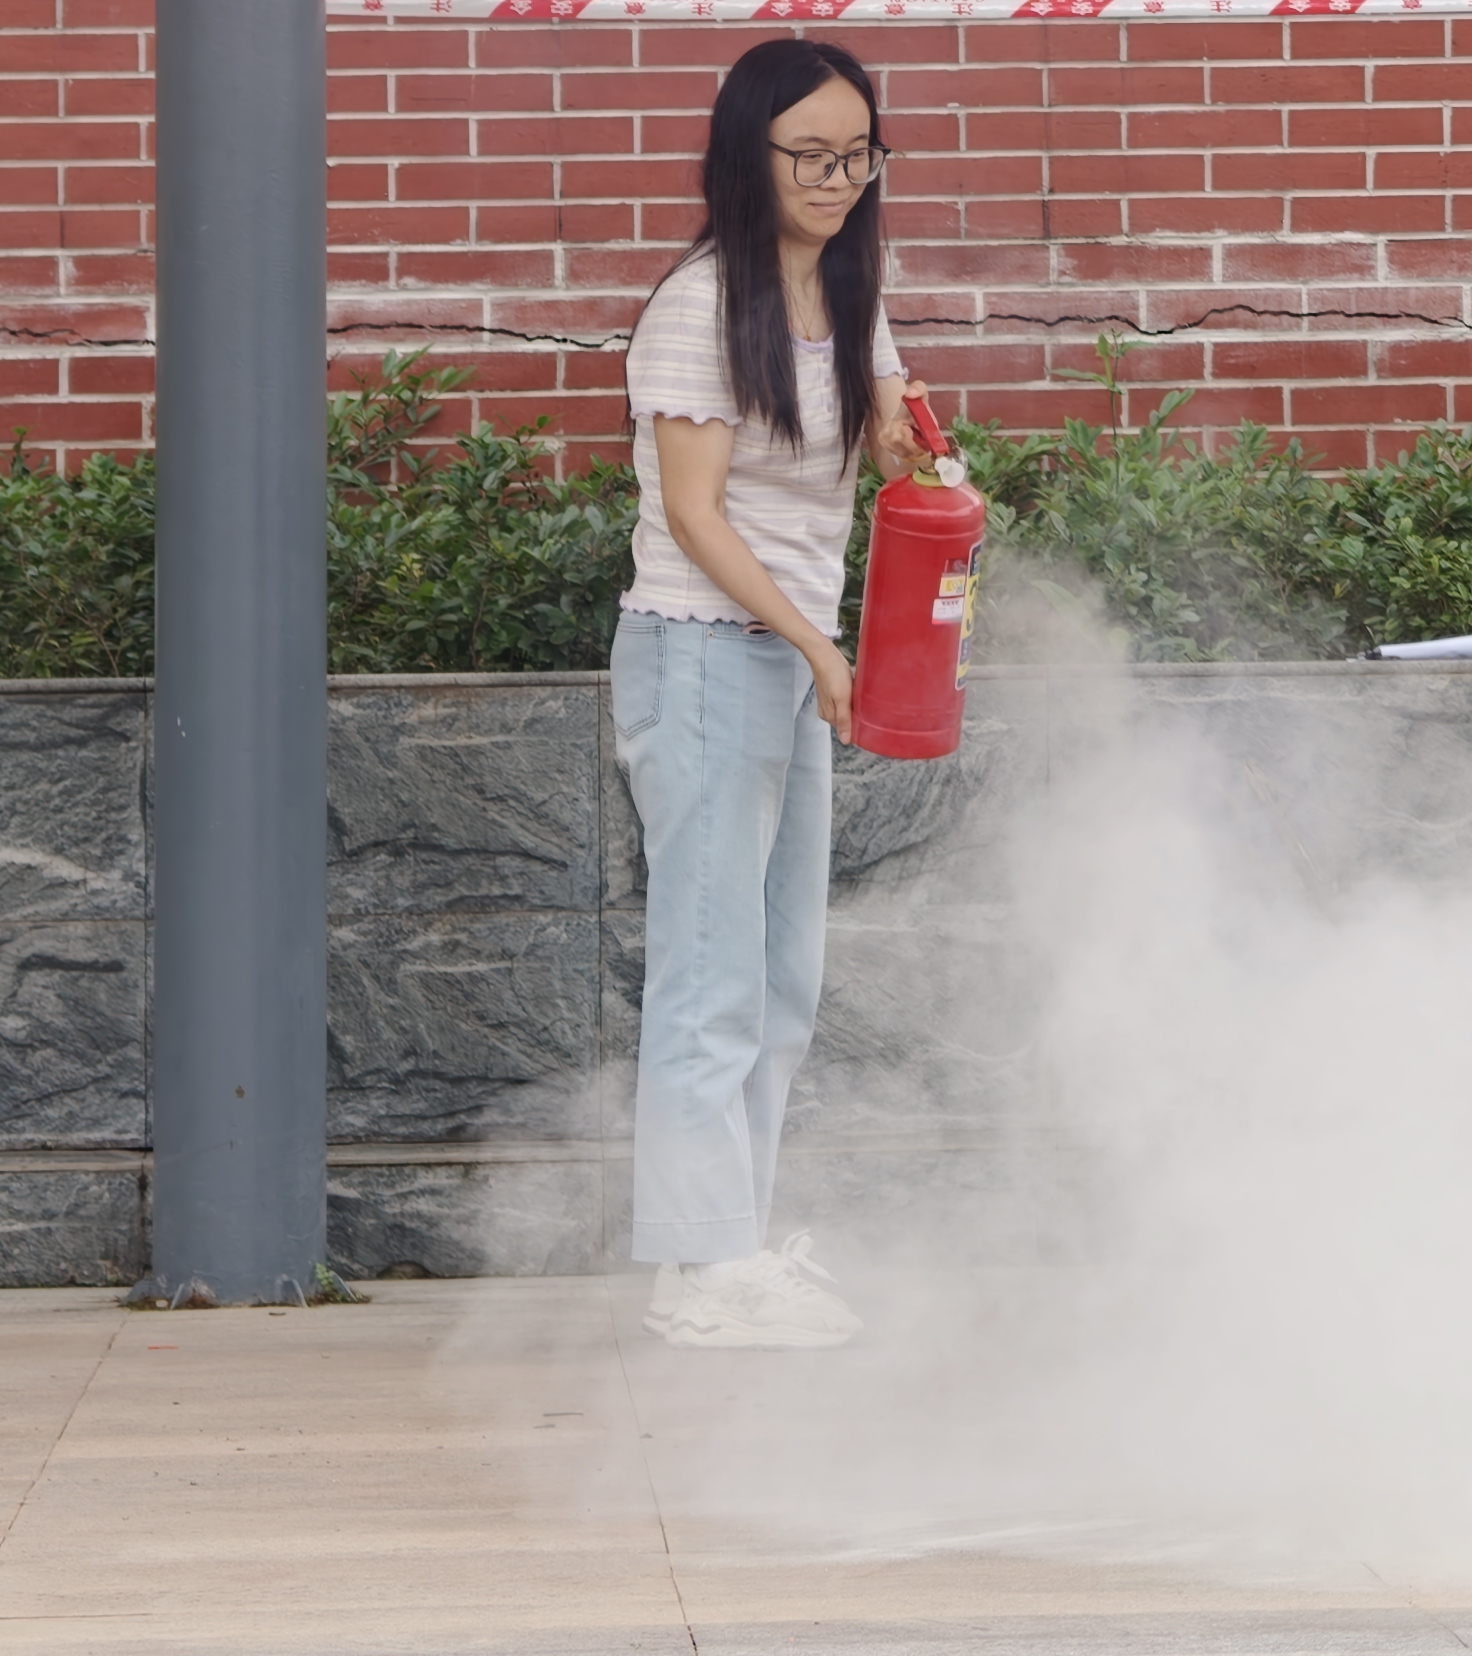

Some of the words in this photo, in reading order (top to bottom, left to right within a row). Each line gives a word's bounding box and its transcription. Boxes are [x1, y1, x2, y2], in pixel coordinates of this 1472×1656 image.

[624, 0, 714, 16] 注意
[770, 1, 834, 17] 安全
[884, 2, 973, 16] 注意
[1030, 0, 1094, 16] 安全
